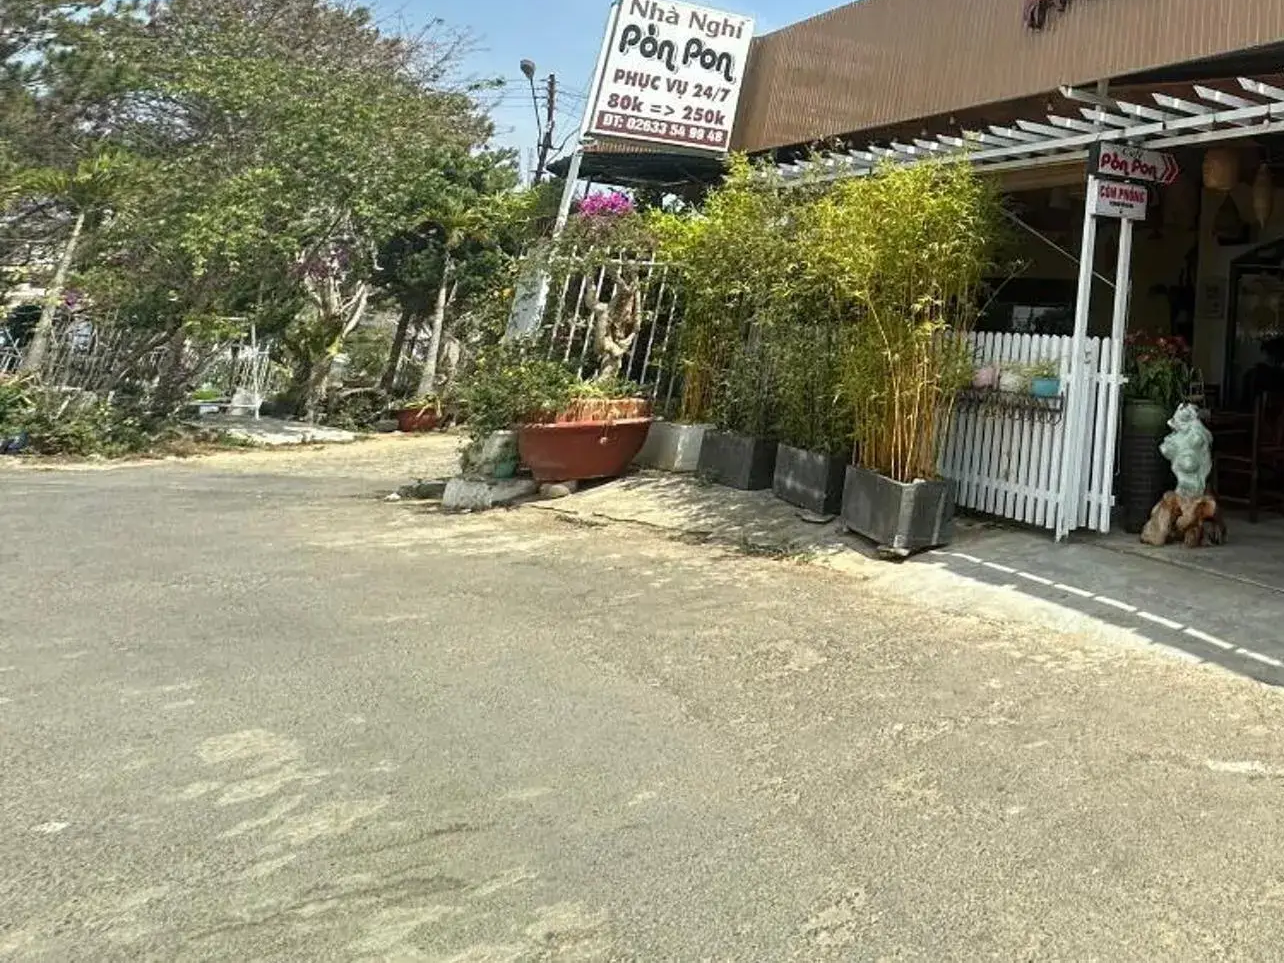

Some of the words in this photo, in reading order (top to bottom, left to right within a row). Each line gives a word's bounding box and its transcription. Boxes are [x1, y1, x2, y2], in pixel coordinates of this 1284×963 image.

[682, 37, 733, 83] Pon
[612, 68, 661, 92] PHỤC
[666, 77, 689, 99] VỤ
[692, 83, 731, 102] 24/7
[607, 93, 644, 113] 80k
[682, 105, 726, 125] 250k
